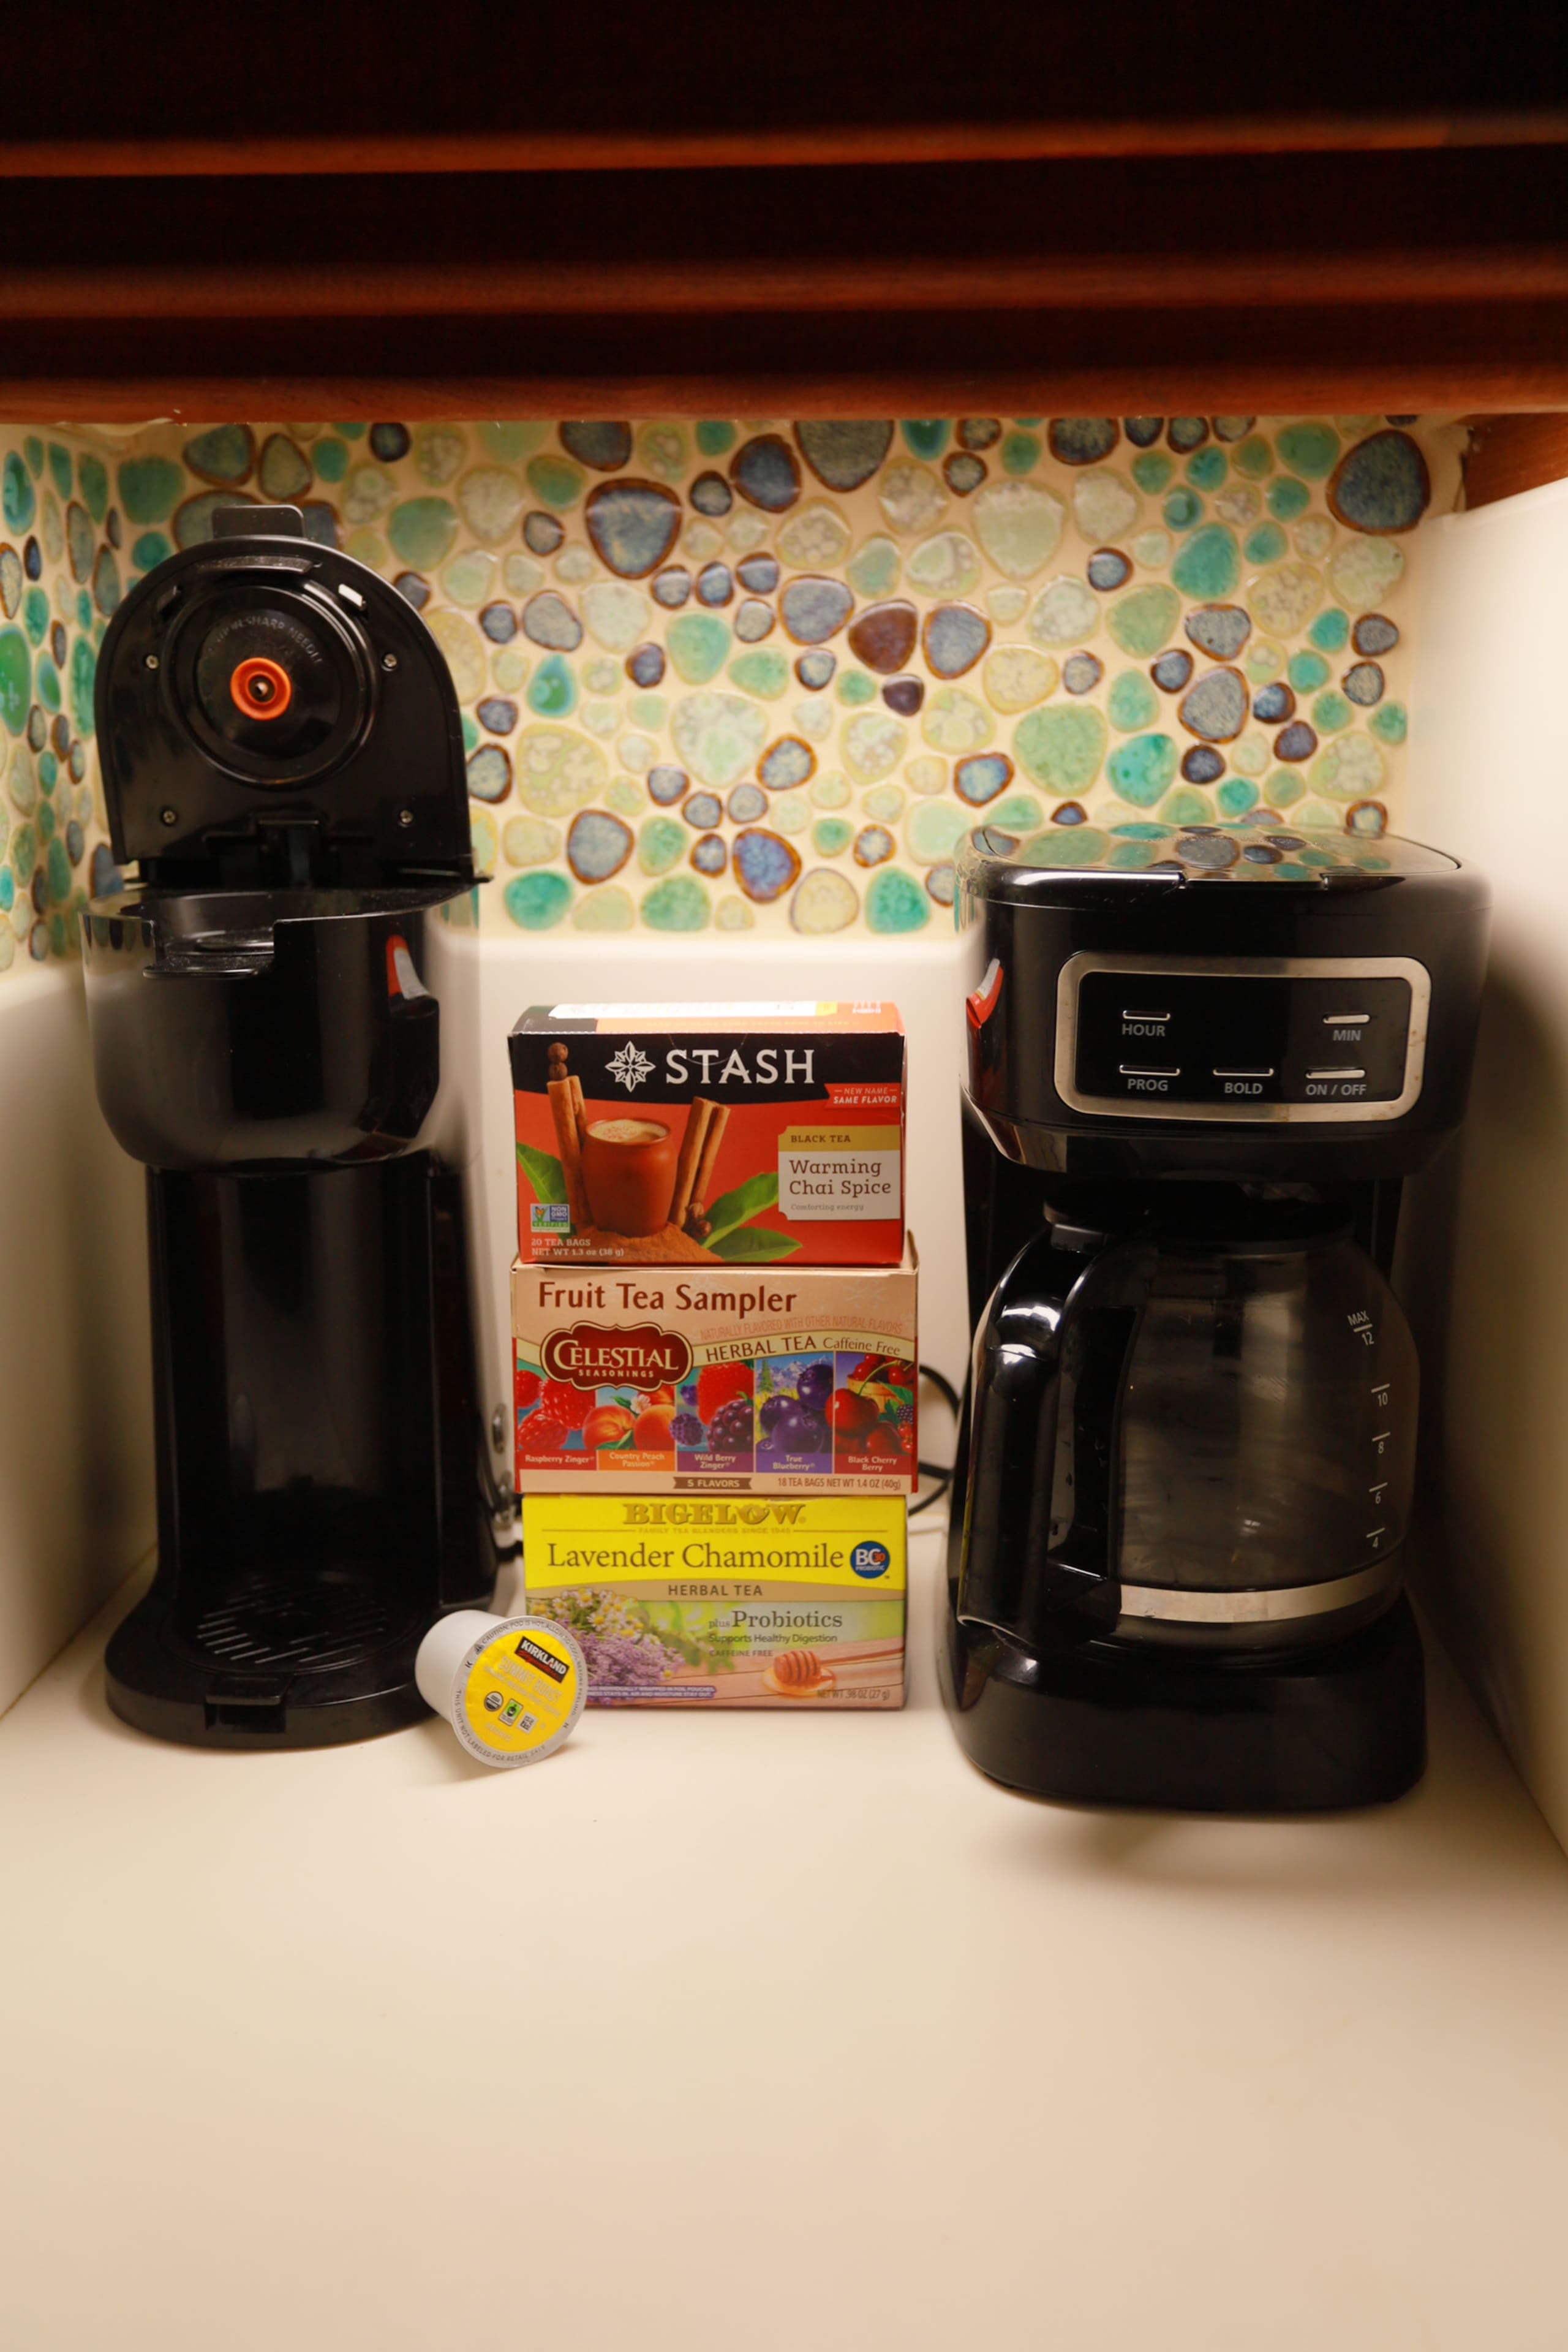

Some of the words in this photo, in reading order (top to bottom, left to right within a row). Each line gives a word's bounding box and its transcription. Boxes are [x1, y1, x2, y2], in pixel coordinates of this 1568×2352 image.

[1121, 1024, 1166, 1037] HOUR
[1333, 1029, 1361, 1042] MIN
[666, 1048, 815, 1084] STASH
[1127, 1078, 1169, 1092] PROG
[1224, 1083, 1263, 1095] BOLD
[1306, 1084, 1329, 1096] ON
[1341, 1084, 1366, 1096] OFF
[789, 1158, 882, 1178] Warming
[789, 1179, 834, 1195] Chai
[840, 1179, 891, 1198] Spice
[538, 1282, 606, 1309] Fruit
[616, 1282, 665, 1309] Tea
[676, 1284, 797, 1319] Sampler
[1348, 1310, 1370, 1326] MAX
[701, 1324, 742, 1341] NATURALLY
[744, 1320, 782, 1334] FLAVORED
[783, 1319, 804, 1330] WITH
[805, 1316, 831, 1328] OTHER
[832, 1316, 867, 1329] NATURAL
[868, 1318, 903, 1334] FLAVORS
[1362, 1332, 1374, 1346] 12
[553, 1339, 679, 1371] CELESTIAL
[706, 1339, 776, 1363] HERBAL
[781, 1336, 816, 1352] TEA
[823, 1337, 872, 1352] Caffeine
[875, 1340, 901, 1356] Free
[578, 1369, 654, 1378] SEASONINGS
[1378, 1393, 1388, 1407] 10
[1378, 1442, 1384, 1454] 8
[525, 1454, 562, 1464] Raspberry
[609, 1452, 640, 1461] Country
[715, 1454, 736, 1463] Berry
[871, 1456, 897, 1465] Cherry
[861, 1464, 883, 1472] Berry
[777, 1477, 786, 1486] 18
[788, 1478, 802, 1487] TEA
[804, 1478, 825, 1487] BAGS
[826, 1478, 842, 1487] NET
[843, 1478, 855, 1487] WT
[857, 1478, 867, 1487] 1.4
[869, 1479, 880, 1488] OZ
[881, 1478, 902, 1490] (40g)
[1375, 1491, 1381, 1504] 6
[623, 1503, 804, 1525] BIGELOW
[1372, 1537, 1379, 1548] 4
[547, 1543, 675, 1568] Lavender
[681, 1543, 844, 1568] Chamomile
[668, 1584, 728, 1597] HERBAL
[733, 1584, 763, 1596] TEA
[709, 1618, 730, 1629] plus
[731, 1610, 843, 1628] Probiotics
[709, 1634, 752, 1644] Supports
[754, 1634, 791, 1644] Healthy
[793, 1634, 838, 1644] Digestion
[521, 1639, 567, 1675] KIRKLAND
[498, 1655, 536, 1687] SUMMIT
[533, 1678, 563, 1705] ROAST
[460, 1725, 470, 1738] NOT
[467, 1738, 490, 1757] LABELED
